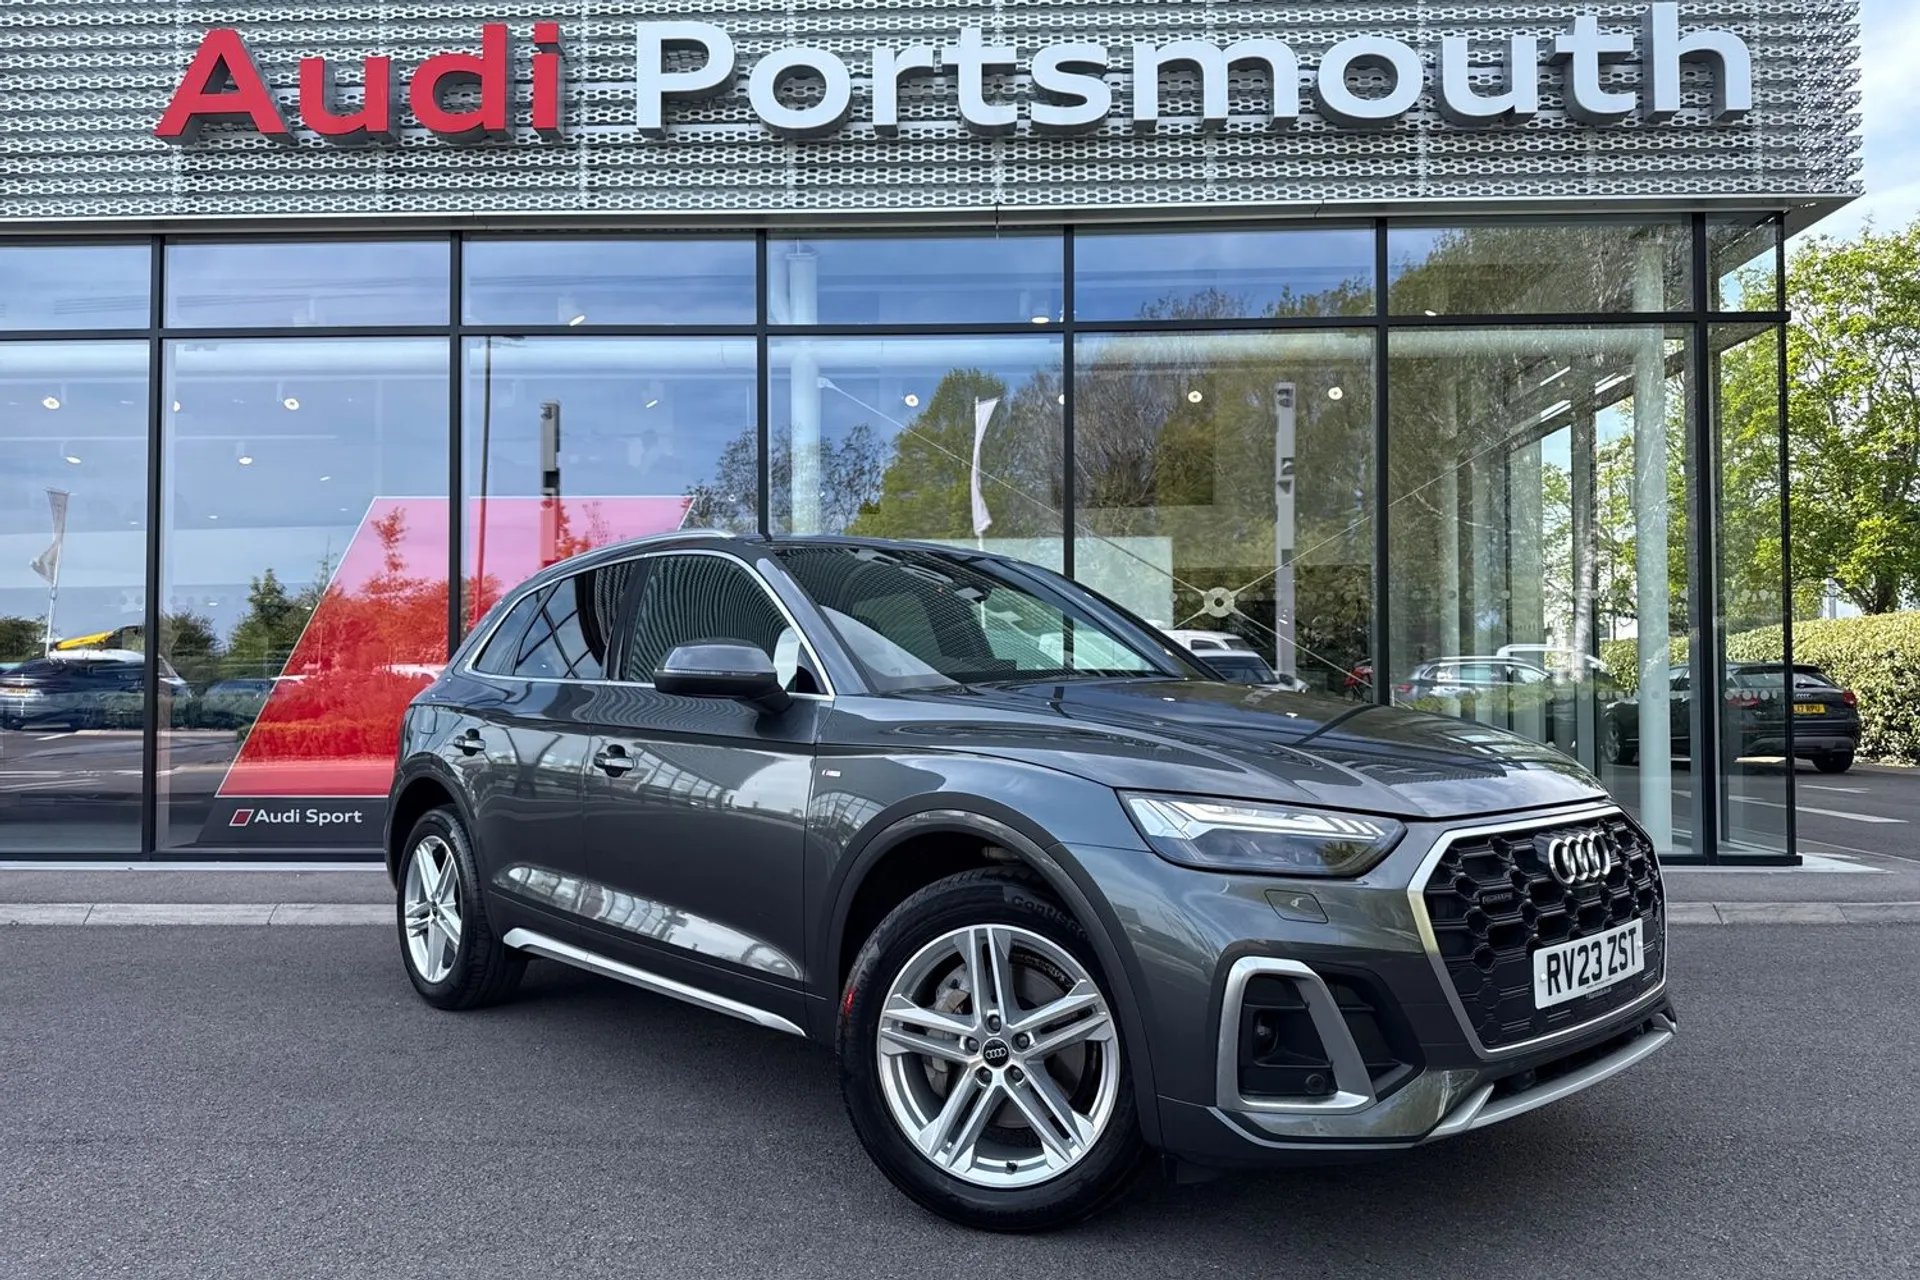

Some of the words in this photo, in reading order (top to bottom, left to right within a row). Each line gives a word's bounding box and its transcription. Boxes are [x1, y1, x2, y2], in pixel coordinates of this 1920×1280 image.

[153, 21, 562, 138] Audi
[636, 1, 1752, 136] Portsmouth
[254, 809, 300, 823] Audi
[305, 809, 363, 826] Sport
[1546, 941, 1603, 996] RV23
[1607, 927, 1637, 976] ZST
